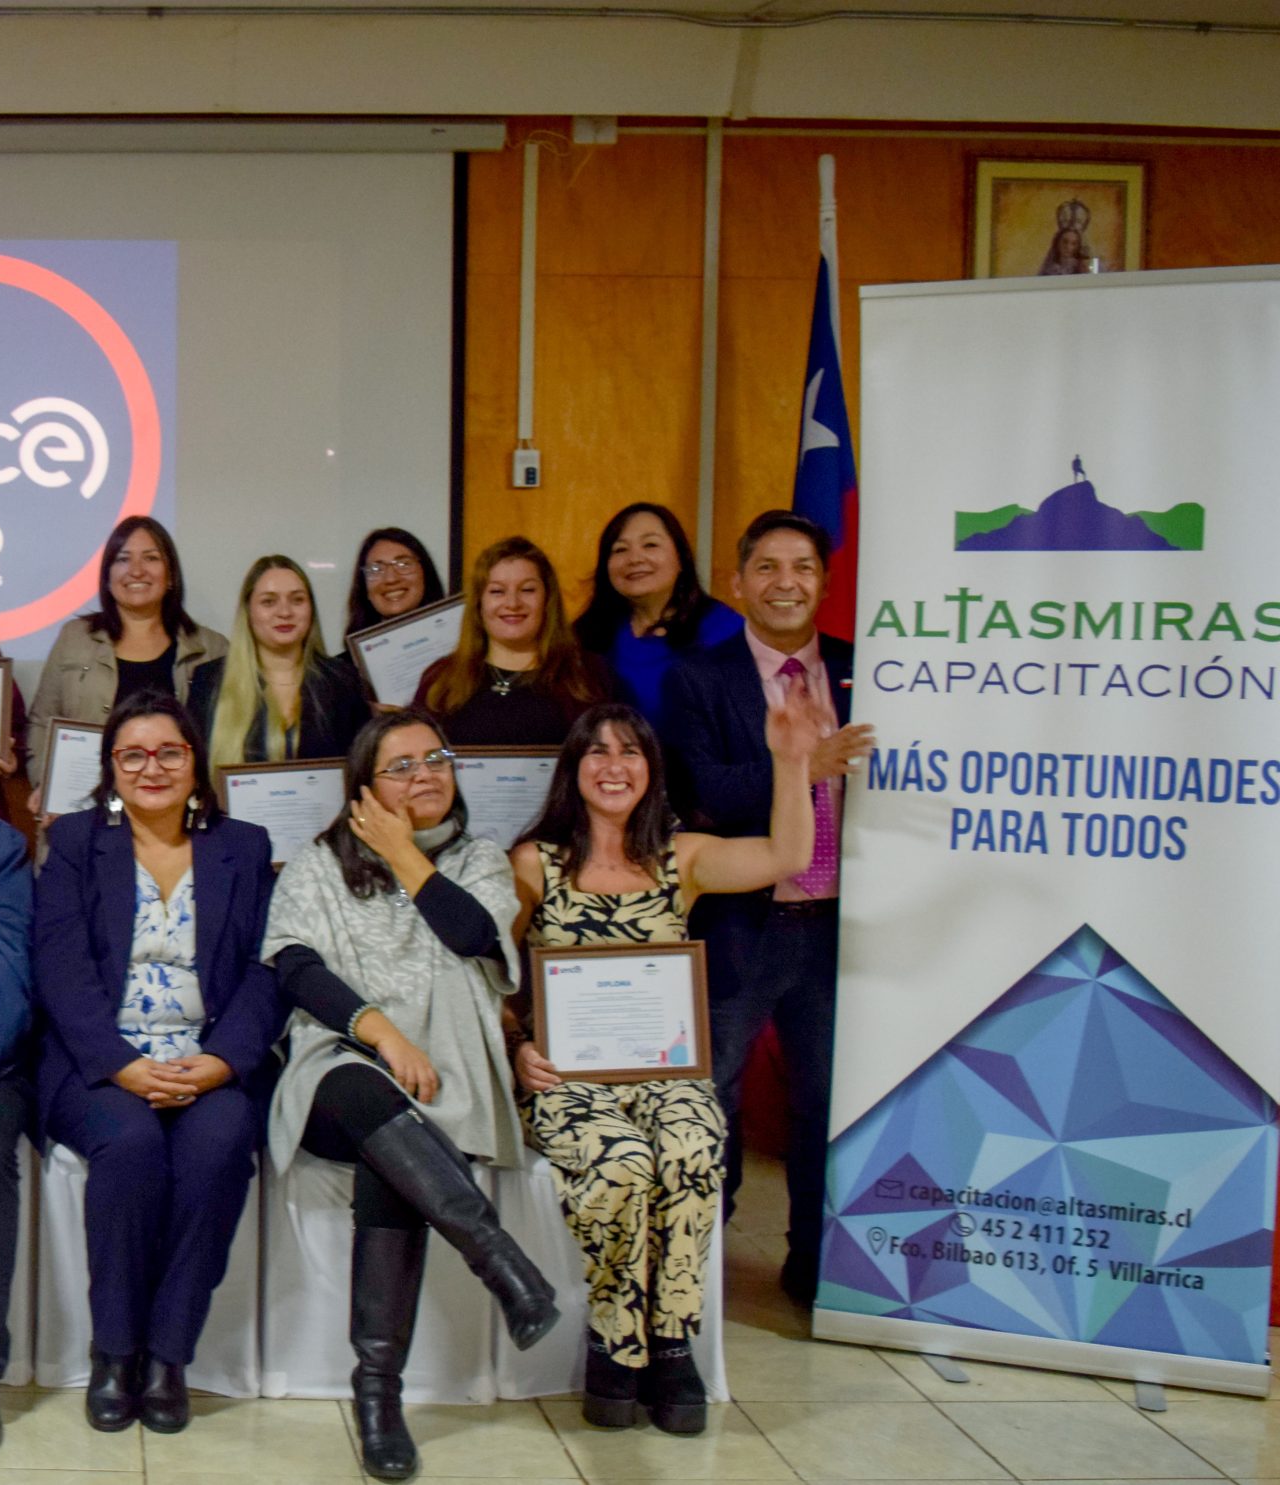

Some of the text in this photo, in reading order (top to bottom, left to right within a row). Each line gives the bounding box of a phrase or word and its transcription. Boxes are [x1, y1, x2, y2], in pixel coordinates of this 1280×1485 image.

[866, 587, 1280, 643] ALTASMIRAS
[873, 655, 1276, 700] CAPACITACIÓN
[867, 740, 1280, 806] MÁS OPORTUNIDADES
[950, 807, 1190, 861] PARA TODOS
[909, 1182, 1193, 1229] capacitacion@altasmiras.cl
[981, 1217, 1111, 1250] 45 2 411 252
[889, 1236, 928, 1257] Fco.
[932, 1240, 997, 1267] Bilbao
[1002, 1251, 1046, 1276] 613,
[1086, 1258, 1099, 1278] 5
[1109, 1260, 1205, 1291] Villarrica
